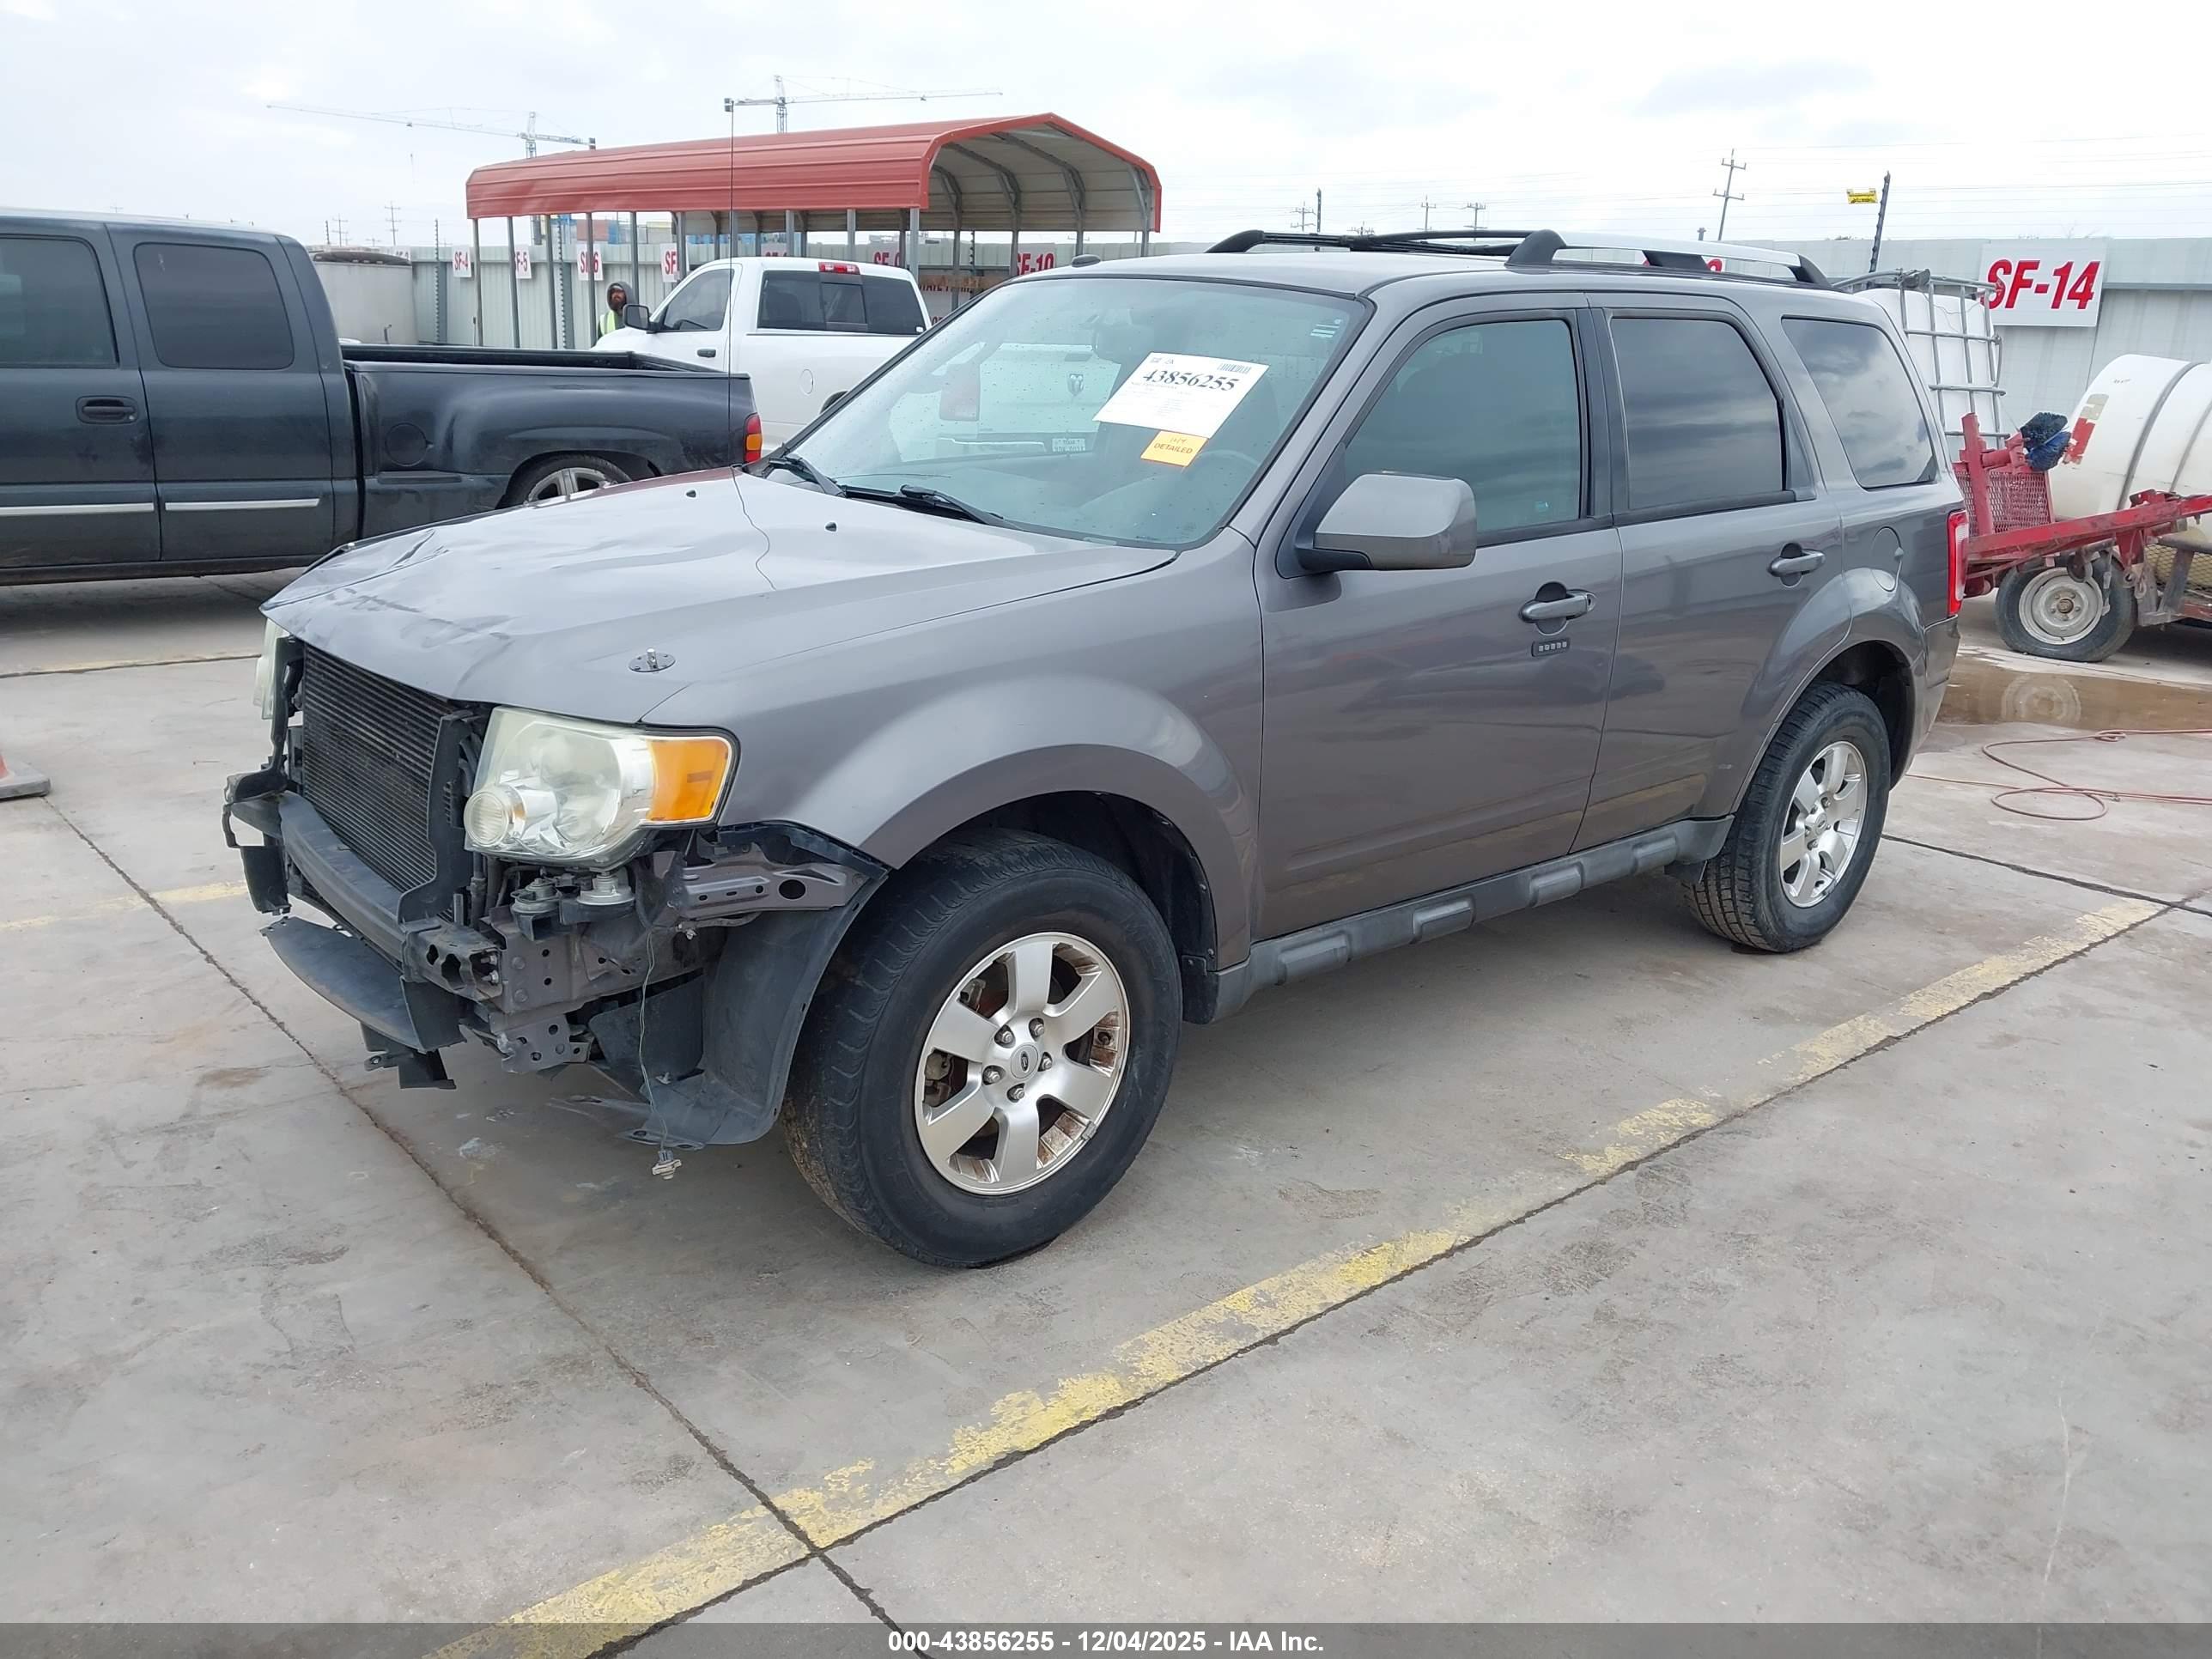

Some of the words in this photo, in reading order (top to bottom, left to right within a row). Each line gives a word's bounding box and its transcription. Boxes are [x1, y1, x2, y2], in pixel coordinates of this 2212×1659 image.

[454, 251, 469, 270] SF-4
[516, 251, 528, 272] F-5
[1979, 258, 2101, 310] SF-14
[1143, 368, 1240, 392] 43856255
[1153, 442, 1193, 454] DETAILED
